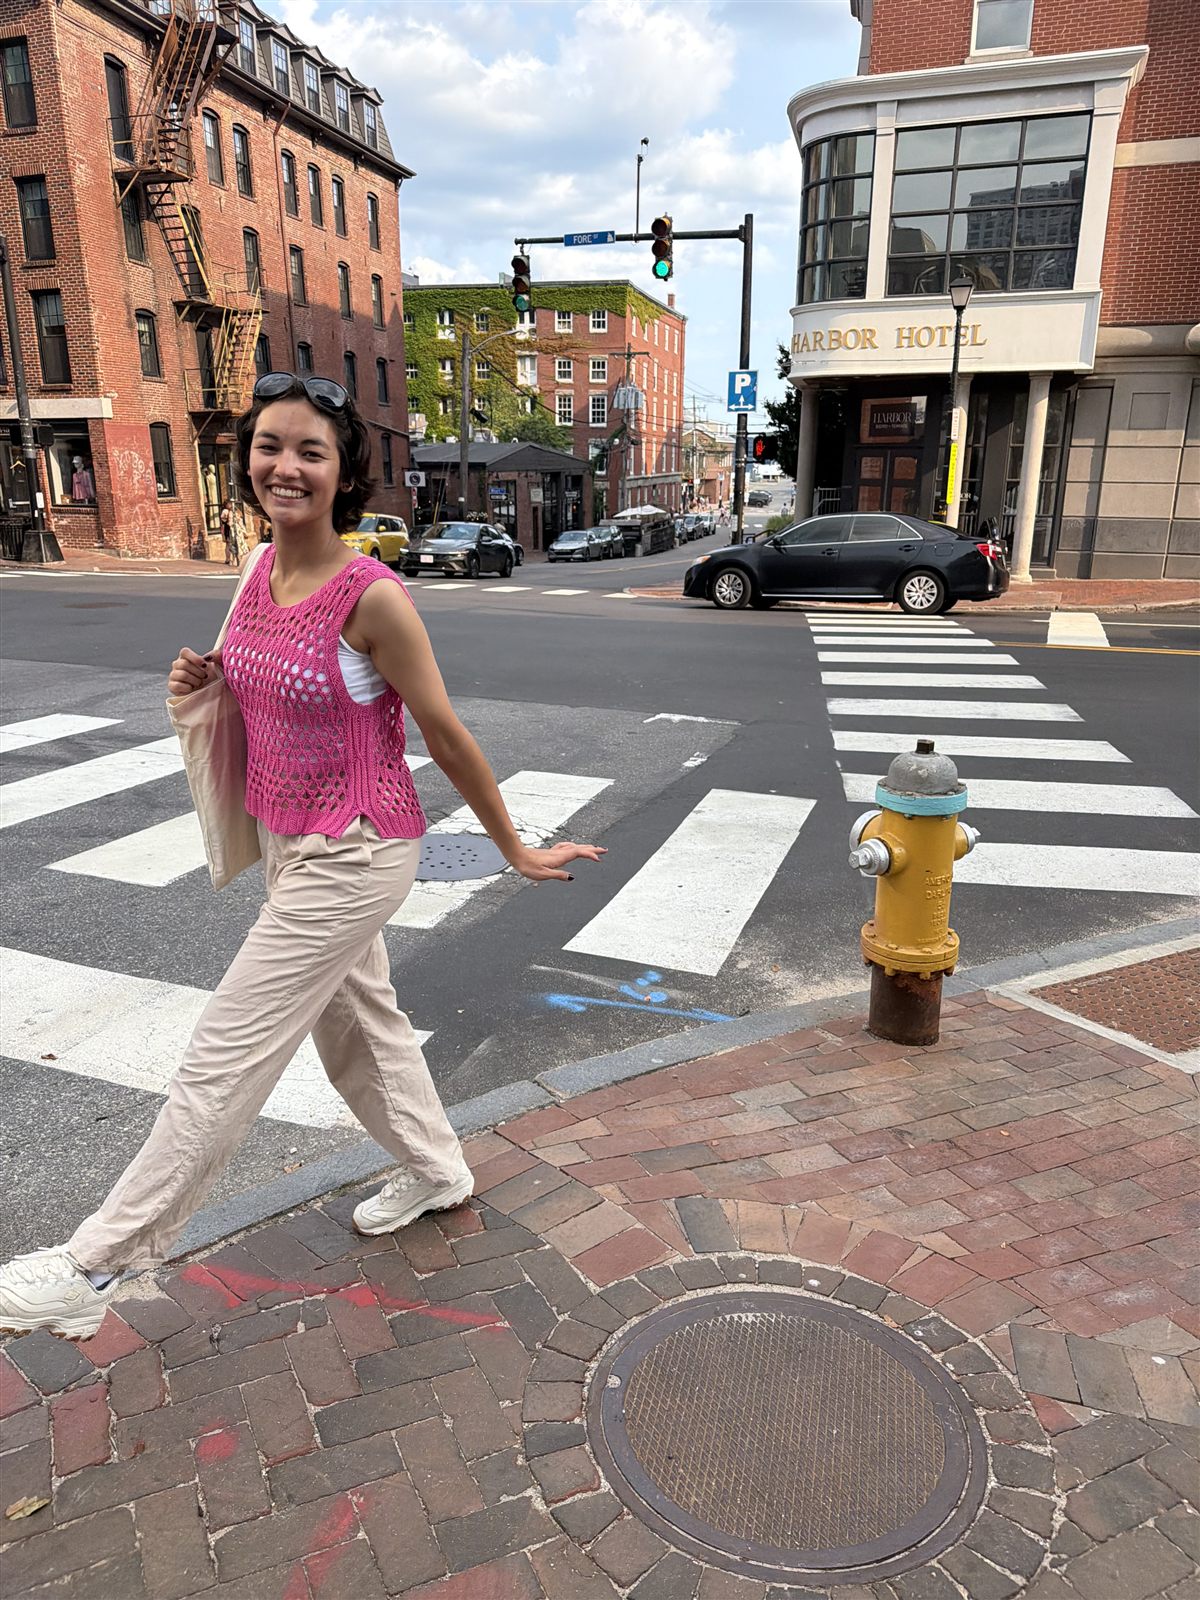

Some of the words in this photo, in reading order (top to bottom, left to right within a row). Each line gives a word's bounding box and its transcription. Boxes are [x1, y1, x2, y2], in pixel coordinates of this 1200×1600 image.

[791, 328, 879, 354] HARBOR
[895, 324, 988, 349] HOTEL
[734, 373, 752, 395] P
[873, 412, 912, 423] HARBOR
